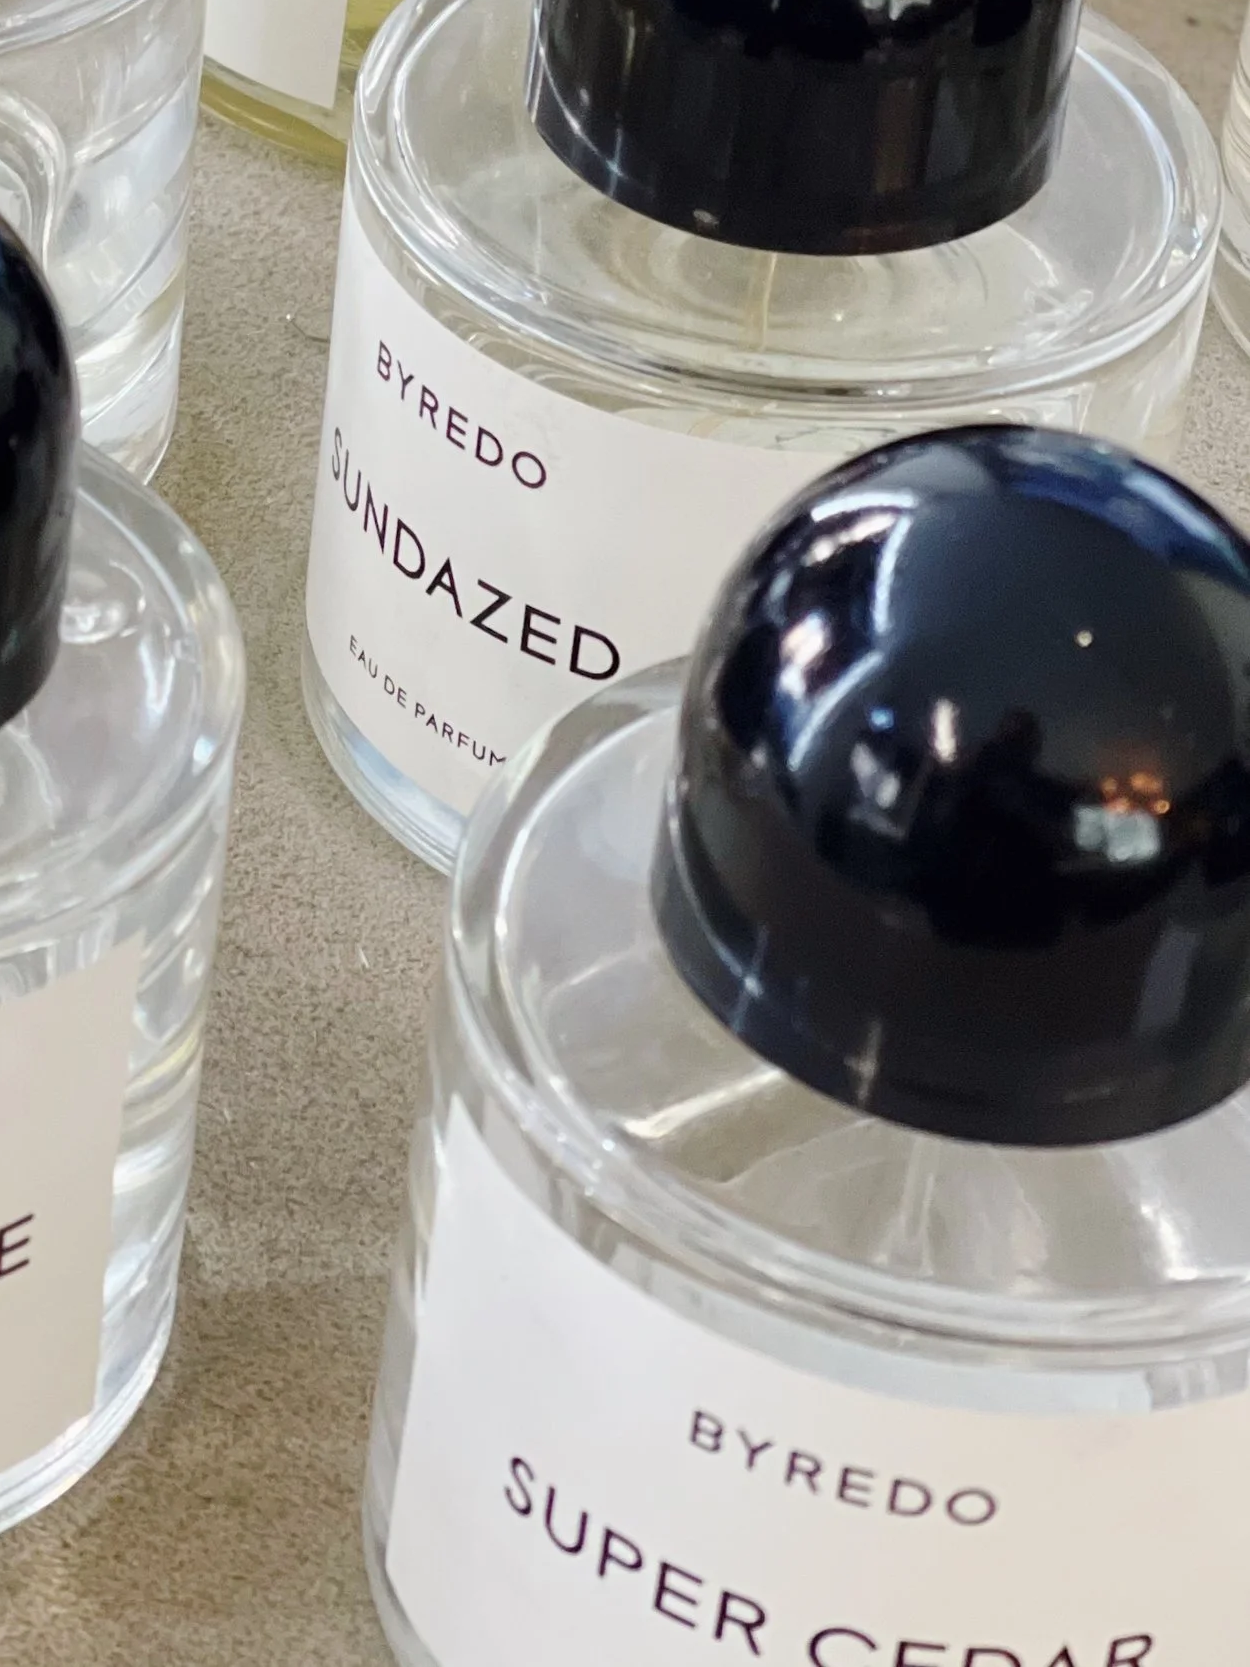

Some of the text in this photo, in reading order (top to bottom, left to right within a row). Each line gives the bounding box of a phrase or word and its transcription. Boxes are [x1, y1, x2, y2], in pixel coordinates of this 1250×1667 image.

[377, 340, 547, 489] BYREDO
[331, 427, 621, 681] SUNDAZED
[349, 634, 378, 679] EAU
[383, 674, 408, 709] DE
[689, 1409, 998, 1526] BYREDO
[504, 1456, 768, 1657] SUPER
